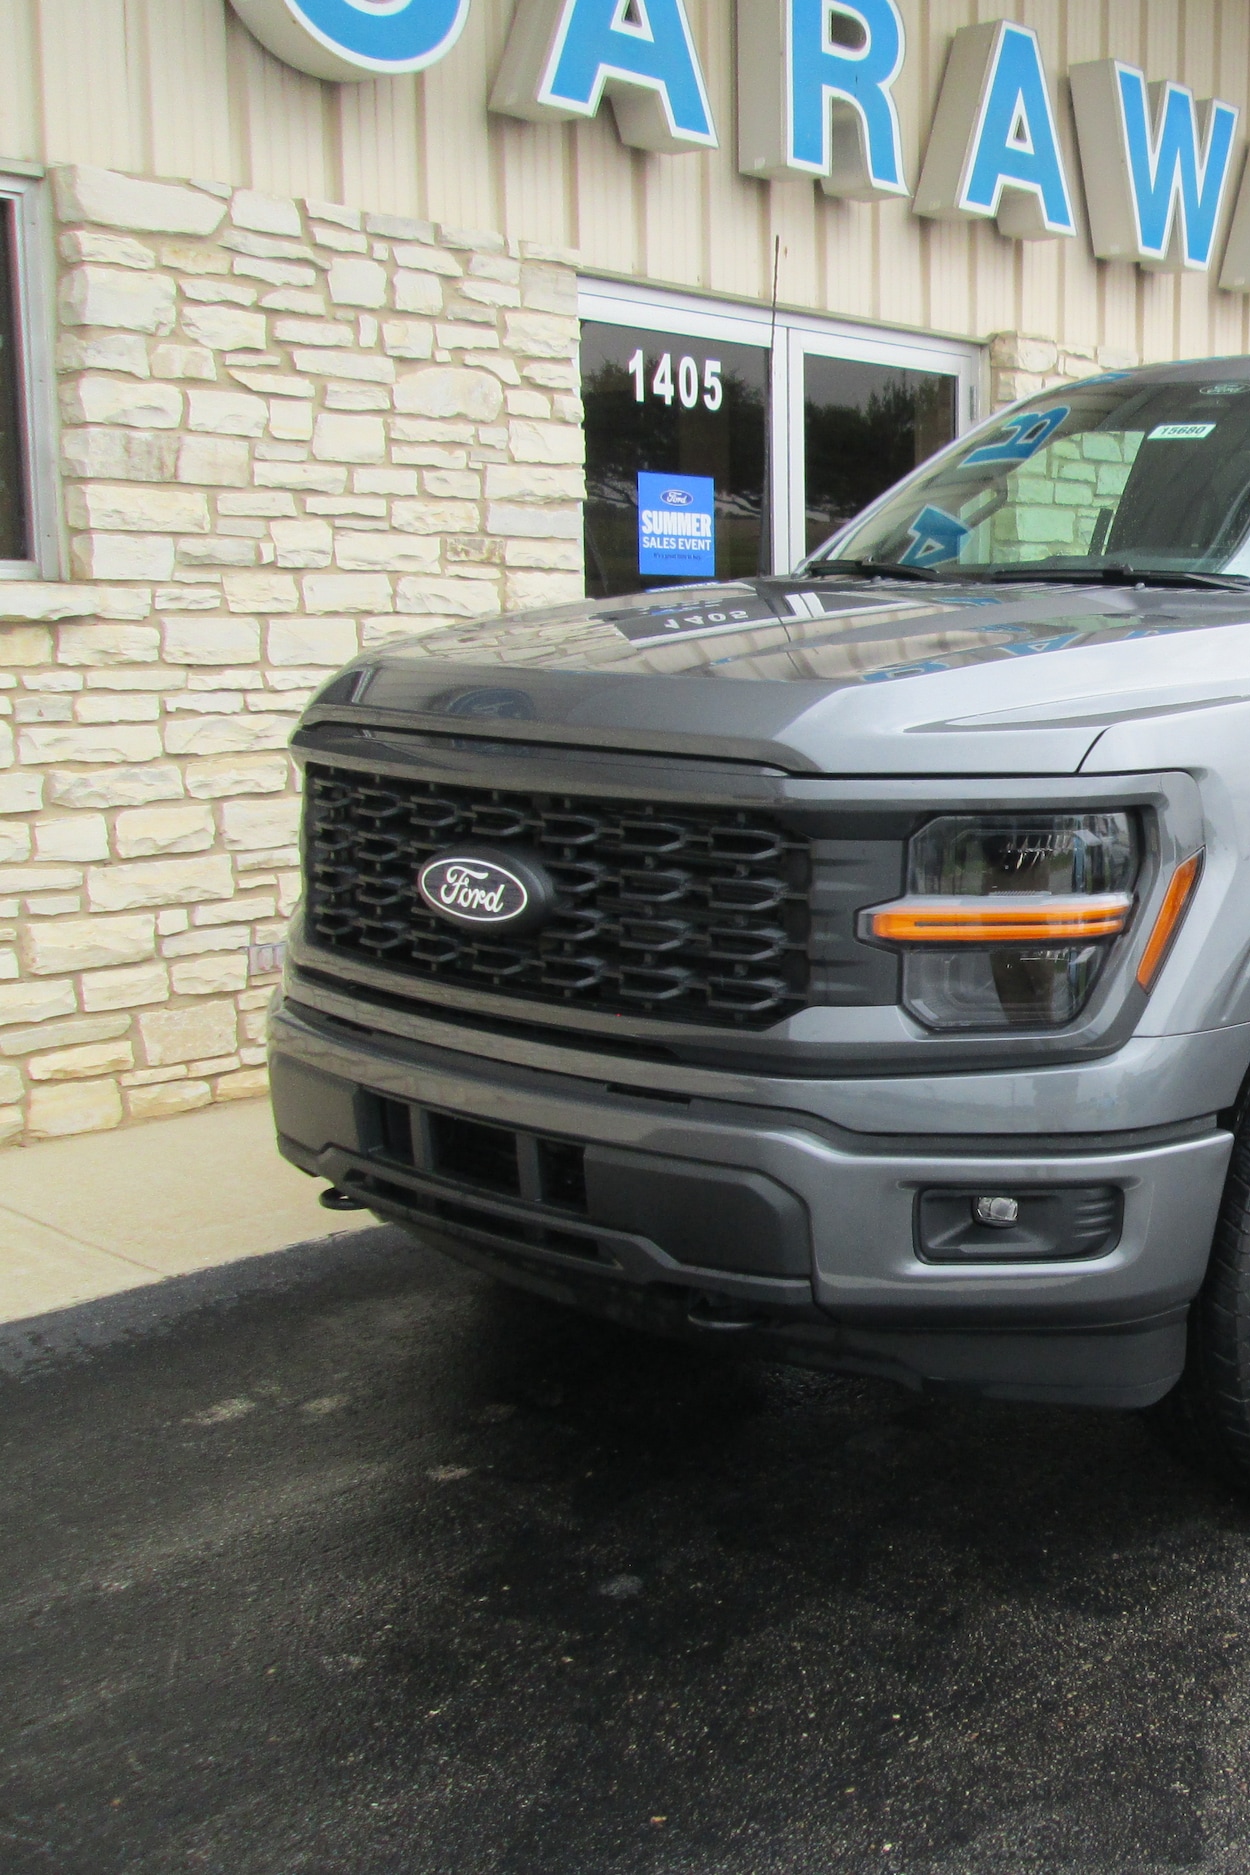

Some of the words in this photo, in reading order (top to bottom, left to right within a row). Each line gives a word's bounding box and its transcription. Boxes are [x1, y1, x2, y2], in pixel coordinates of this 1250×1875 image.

[627, 348, 723, 411] 1405
[1160, 426, 1207, 435] 15680
[666, 491, 688, 504] Ford
[641, 509, 712, 538] SUMMER
[642, 537, 676, 549] SALES
[678, 538, 712, 551] EVENT
[440, 865, 504, 913] Ford
